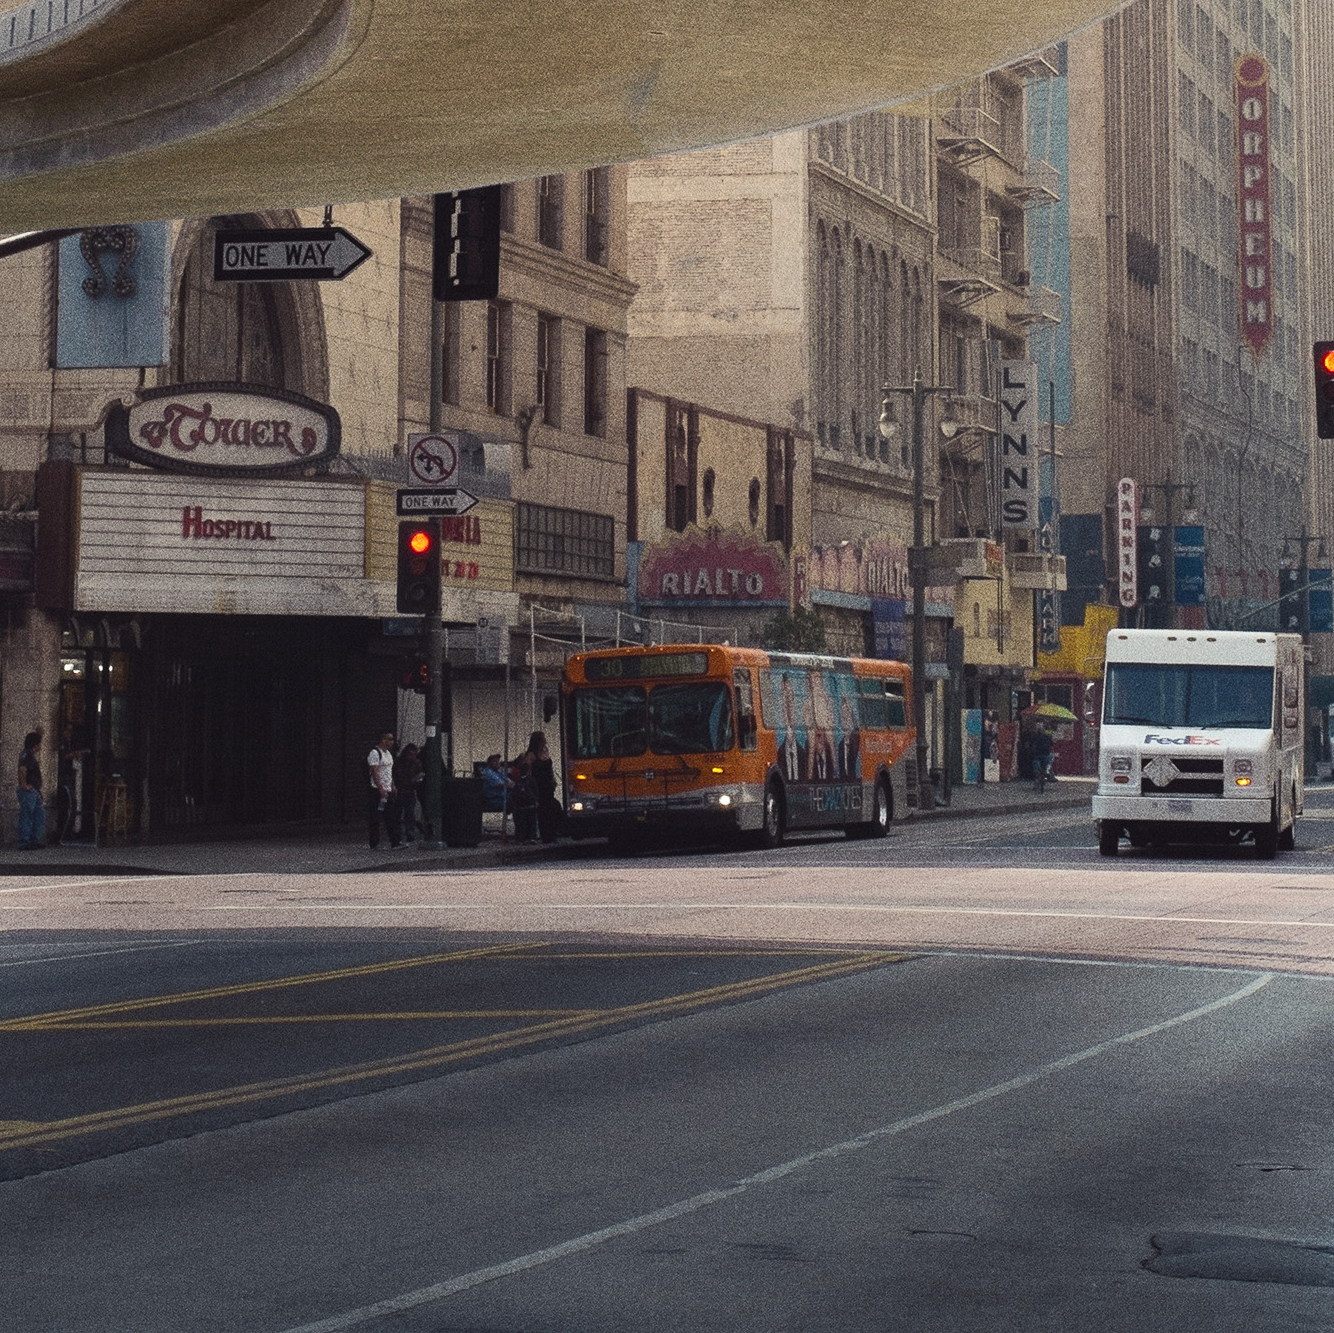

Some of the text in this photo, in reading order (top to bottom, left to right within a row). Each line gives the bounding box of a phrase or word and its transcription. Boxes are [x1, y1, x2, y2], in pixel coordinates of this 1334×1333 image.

[1242, 97, 1268, 324] ORPHEUM
[225, 243, 332, 267] ONE WAY
[1003, 367, 1027, 523] LYNNS
[405, 496, 455, 508] ONE WAY
[1121, 482, 1135, 601] PARKING
[662, 568, 764, 596] RIALTO
[1144, 734, 1221, 746] FedEx
